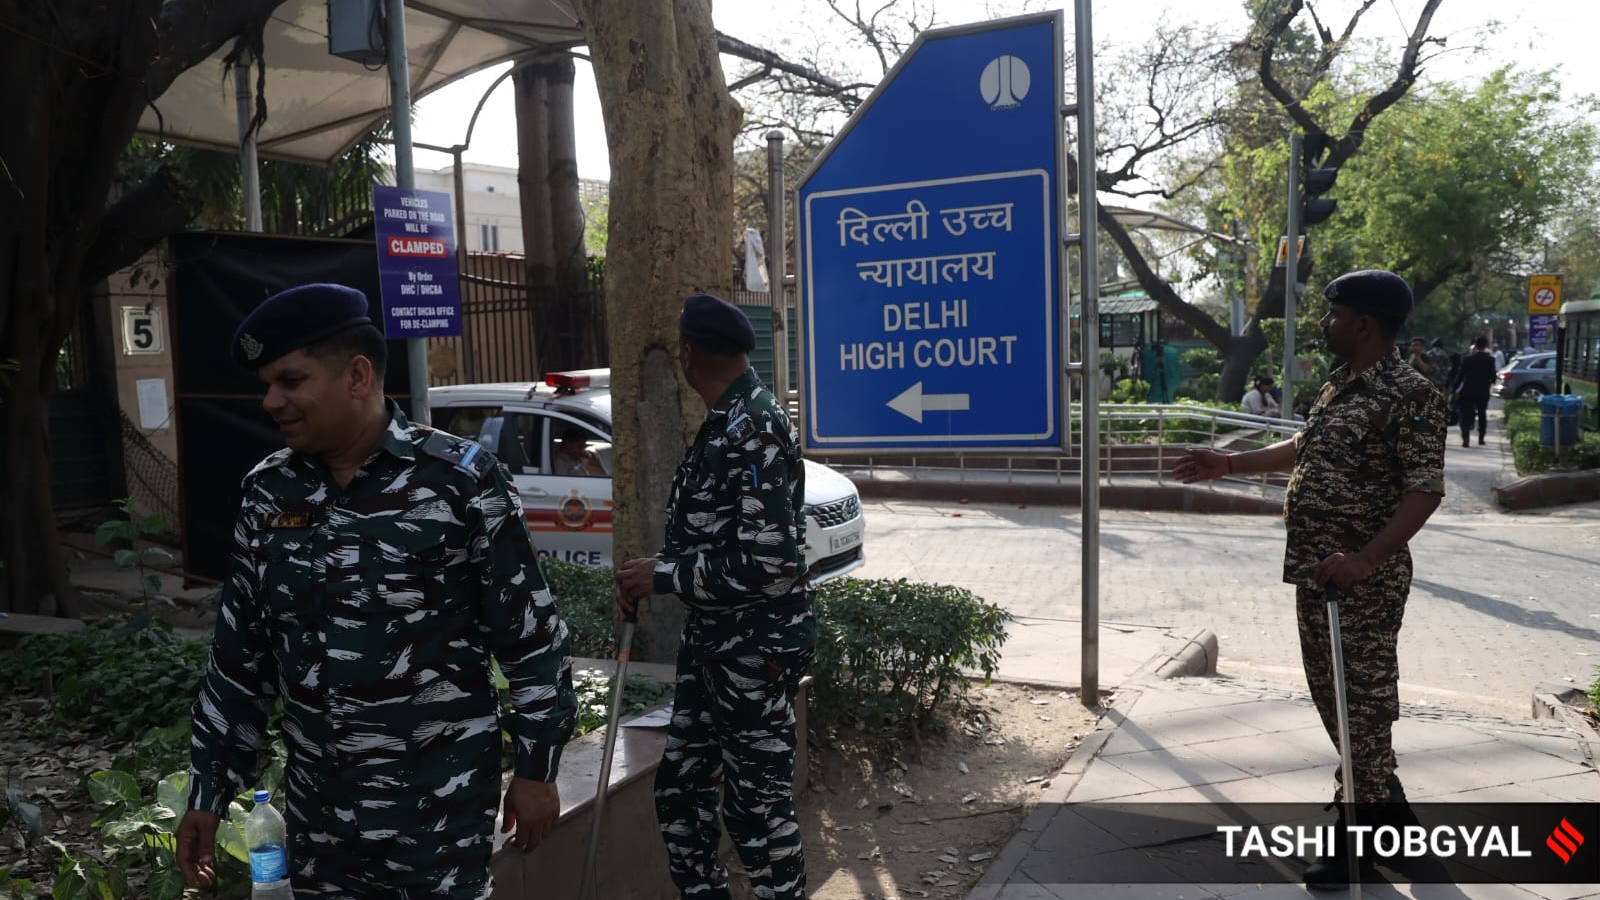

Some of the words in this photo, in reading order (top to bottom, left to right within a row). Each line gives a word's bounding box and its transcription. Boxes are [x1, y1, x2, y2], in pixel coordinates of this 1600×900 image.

[401, 197, 428, 209] VEHICLES
[384, 208, 407, 219] PARKED
[409, 210, 417, 220] ON
[418, 211, 429, 221] THE
[405, 223, 419, 233] WILL
[420, 224, 428, 233] BE
[837, 199, 930, 247] दिल्ली
[940, 202, 1014, 237] उच्च
[391, 239, 444, 255] CLAMPED
[856, 251, 996, 287] न्यायालय
[408, 272, 416, 282] By
[417, 272, 433, 281] Order
[401, 284, 415, 295] DHC
[391, 307, 416, 317] CONTACT
[436, 306, 454, 315] OFFICE
[883, 300, 968, 332] DELHI
[400, 320, 412, 329] FOR
[413, 319, 448, 329] DE-CLAMPING
[134, 319, 153, 349] 5
[840, 341, 904, 370] HIGH
[913, 336, 1017, 367] COURT
